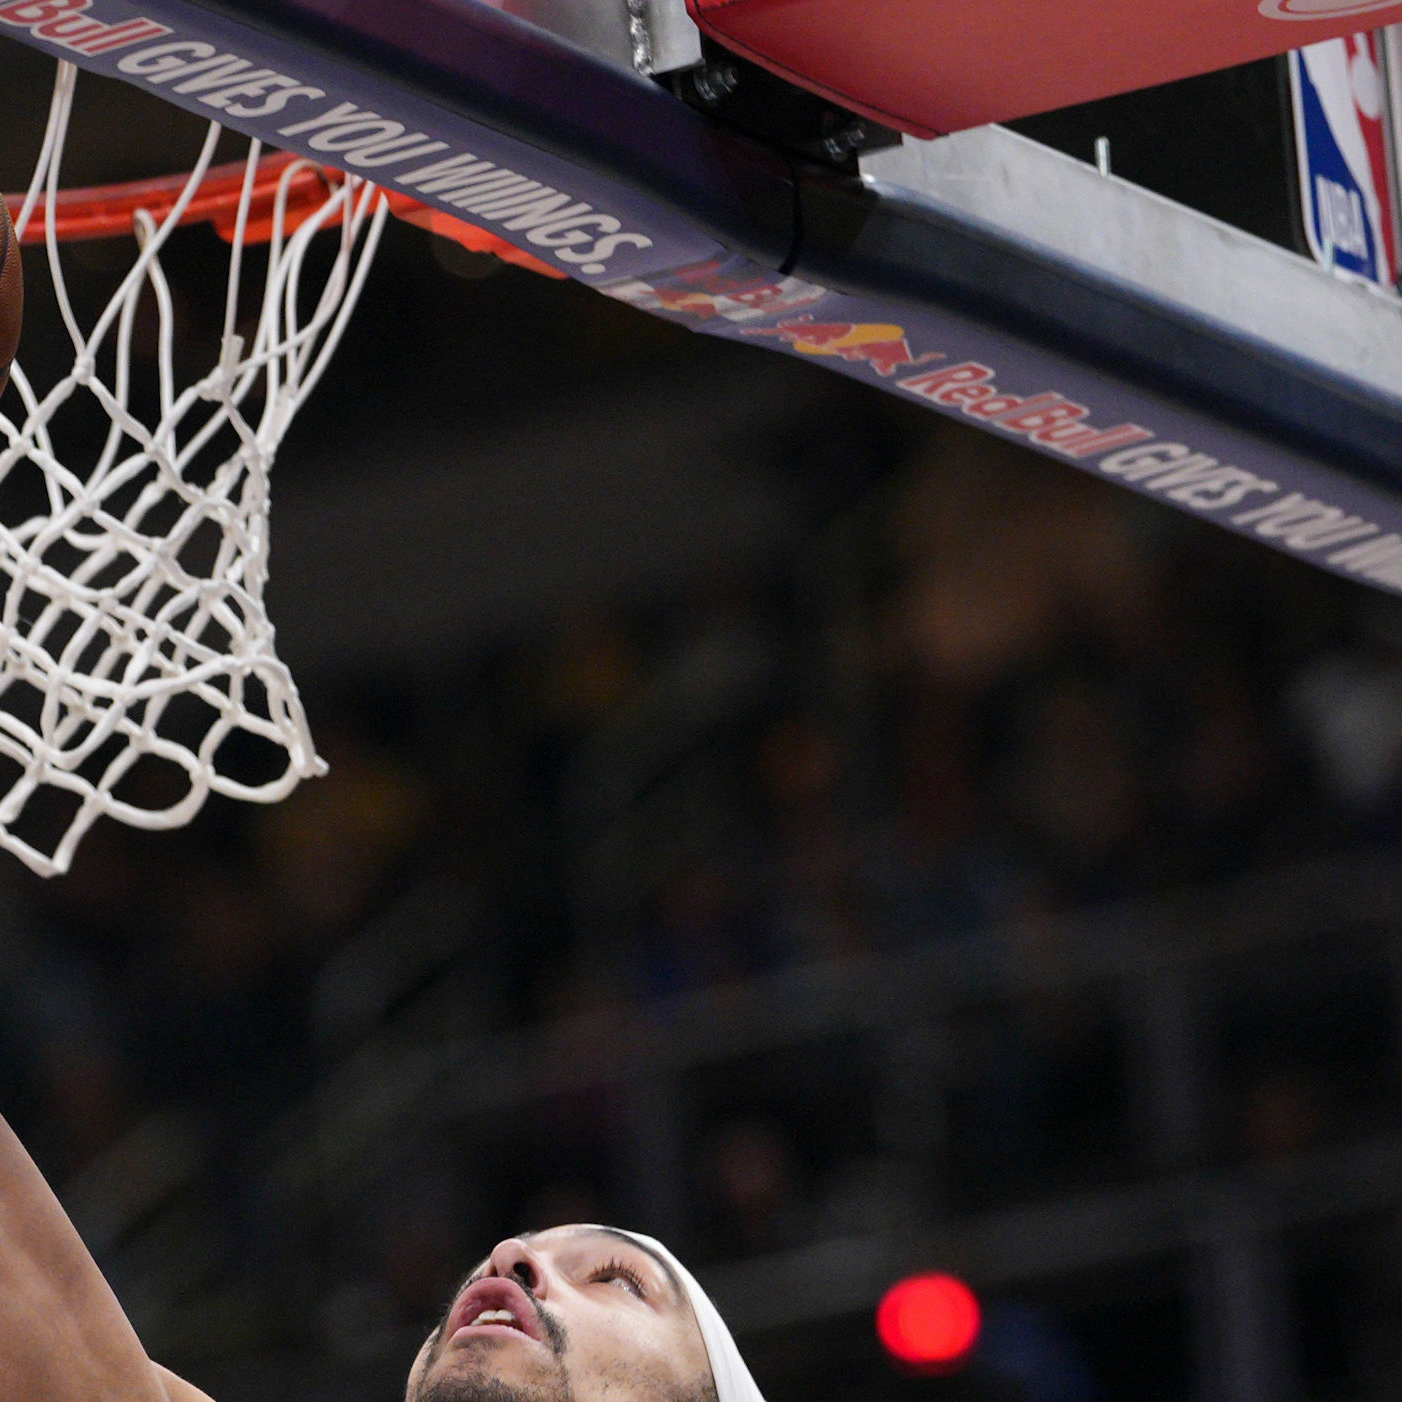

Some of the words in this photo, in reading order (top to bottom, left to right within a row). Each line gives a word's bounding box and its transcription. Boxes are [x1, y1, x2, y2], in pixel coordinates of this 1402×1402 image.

[117, 41, 326, 118] GIVES
[277, 101, 450, 168] YOU
[1099, 442, 1280, 511] GIVES
[1232, 491, 1380, 552] YOU
